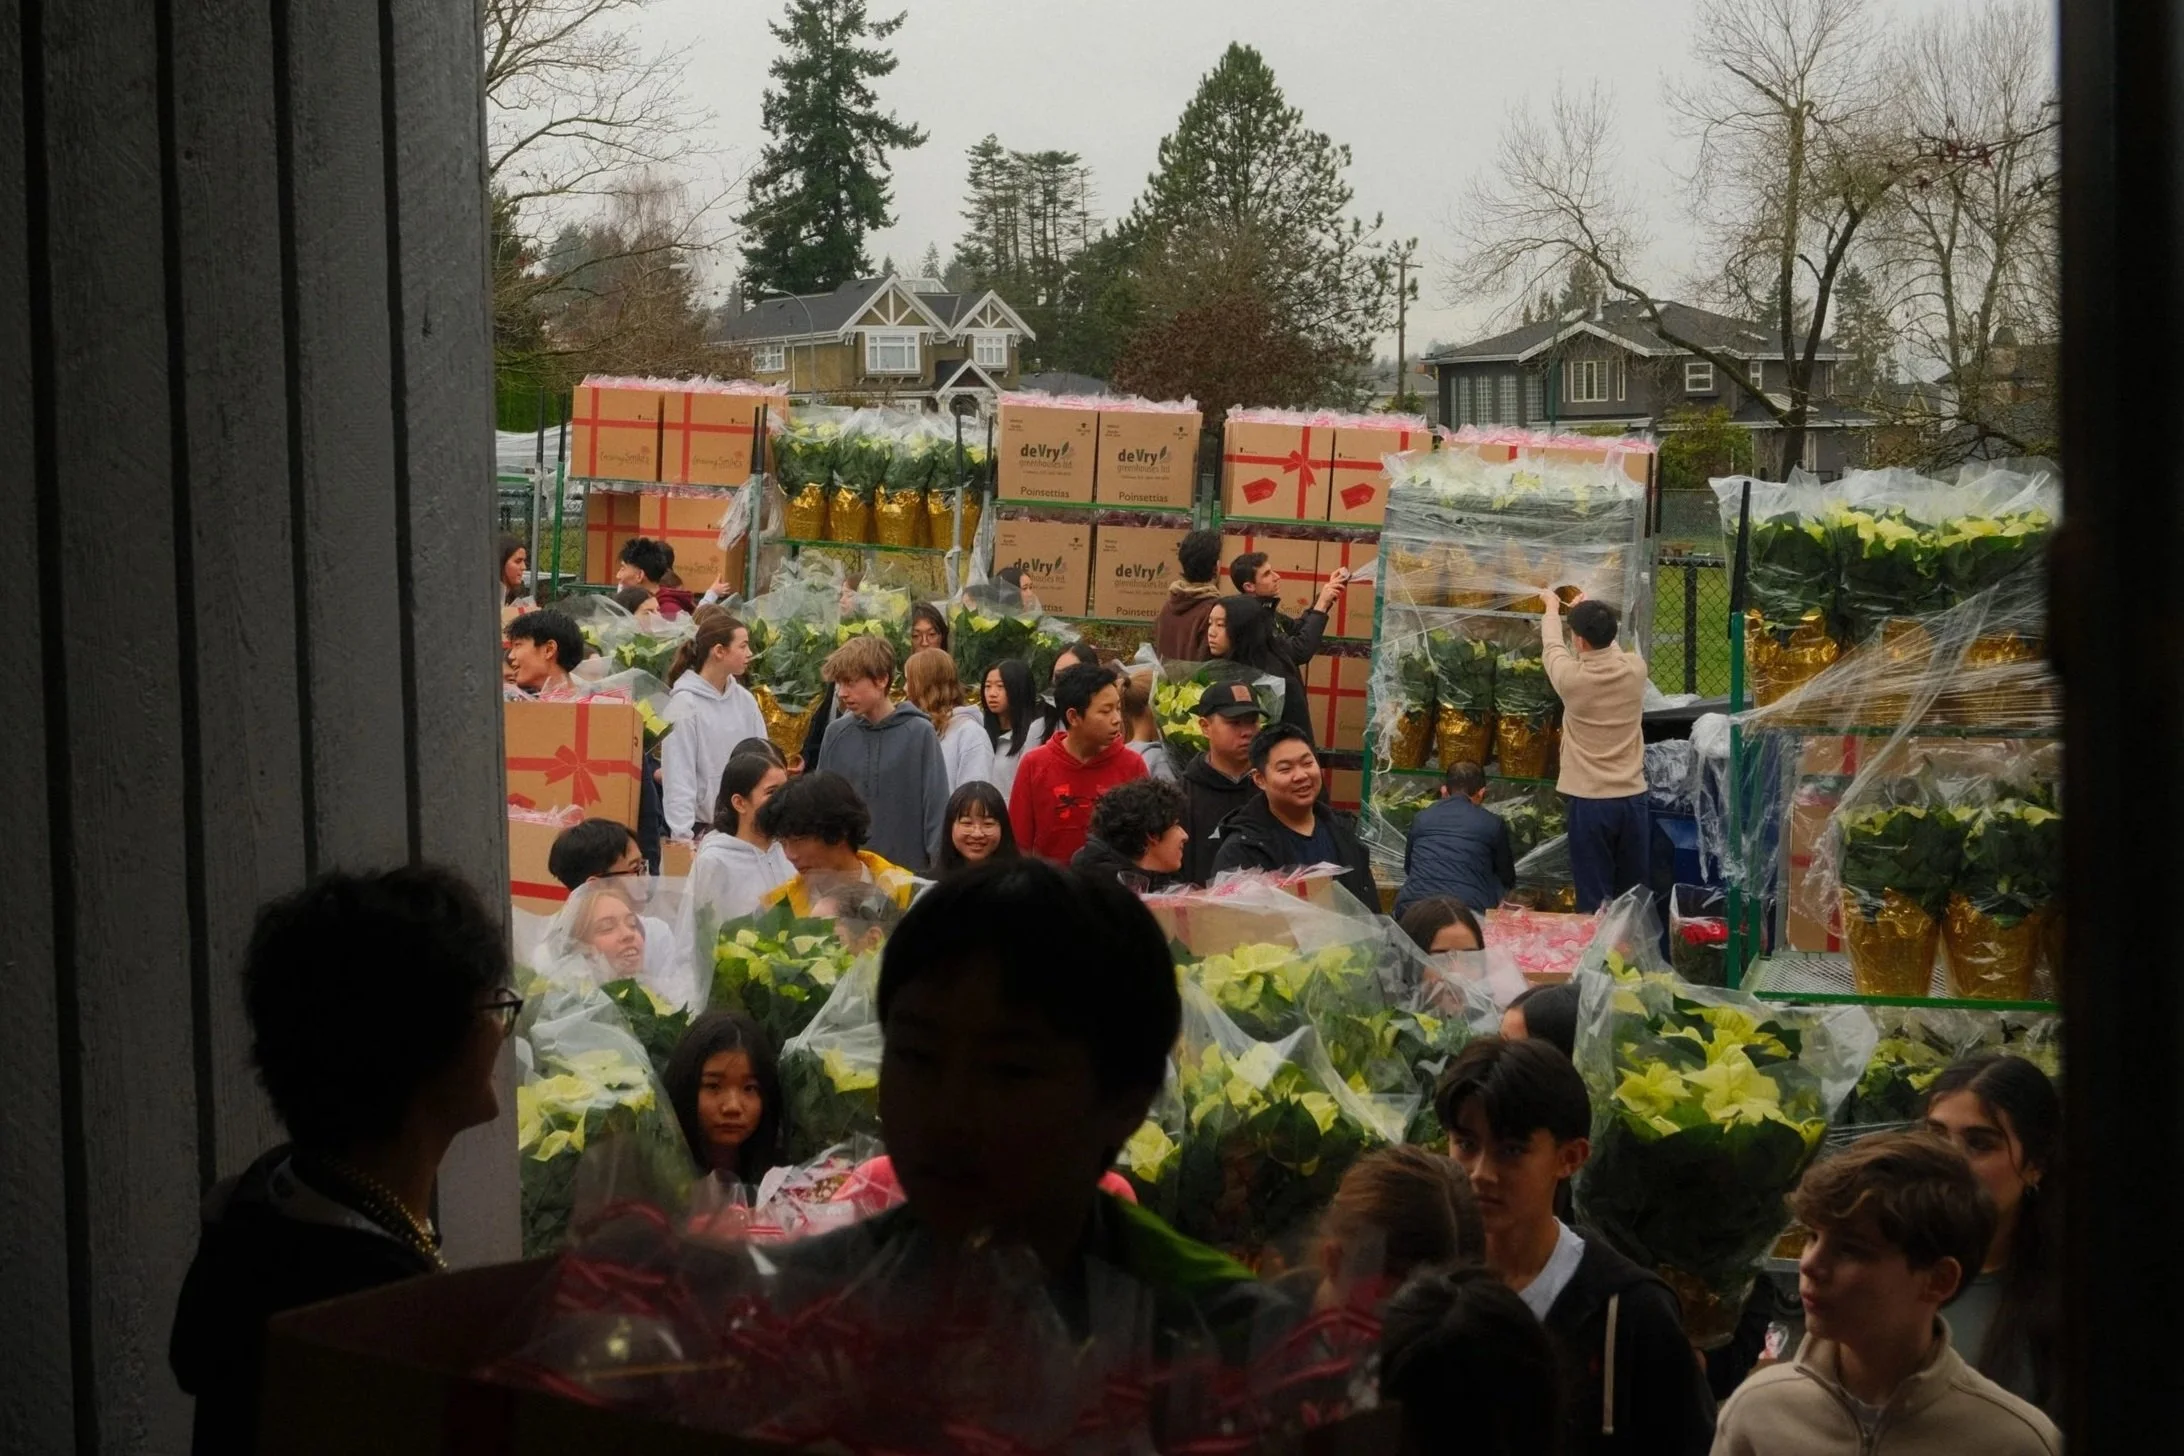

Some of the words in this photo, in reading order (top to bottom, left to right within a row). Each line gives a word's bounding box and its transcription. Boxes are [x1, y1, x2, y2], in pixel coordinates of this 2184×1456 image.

[1020, 443, 1061, 464] deVry
[1117, 448, 1158, 467] deVry
[1020, 486, 1070, 498] Poinsettias
[1119, 491, 1169, 503] Poinsettias
[1014, 557, 1054, 576] deVry
[1115, 563, 1156, 582] deVry
[1031, 574, 1055, 583] houses
[1116, 606, 1159, 617] Poinsetti
